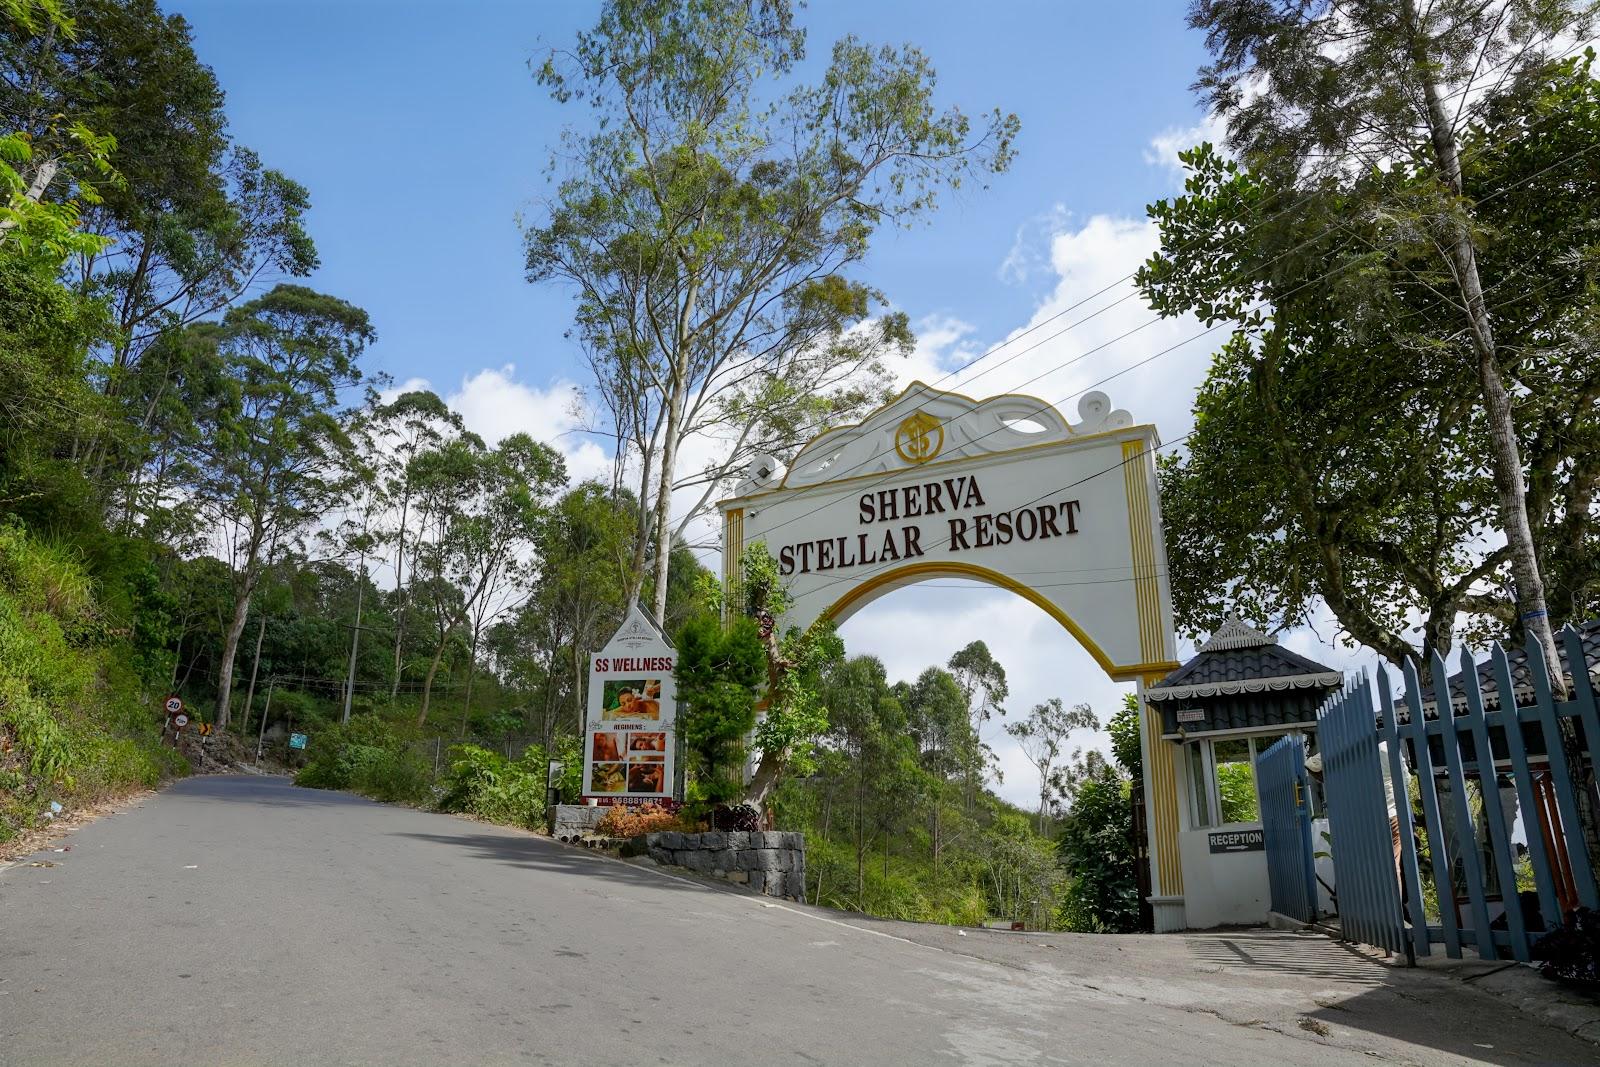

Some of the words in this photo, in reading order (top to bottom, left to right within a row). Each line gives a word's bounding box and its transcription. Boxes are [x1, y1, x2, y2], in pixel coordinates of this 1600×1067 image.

[859, 475, 986, 524] SHERVA
[779, 525, 925, 576] STELLAR
[948, 500, 1081, 551] RESORT
[595, 657, 609, 673] SS
[613, 656, 672, 672] WELLNESS
[168, 701, 180, 709] 20
[1210, 832, 1263, 846] RECEPTION
